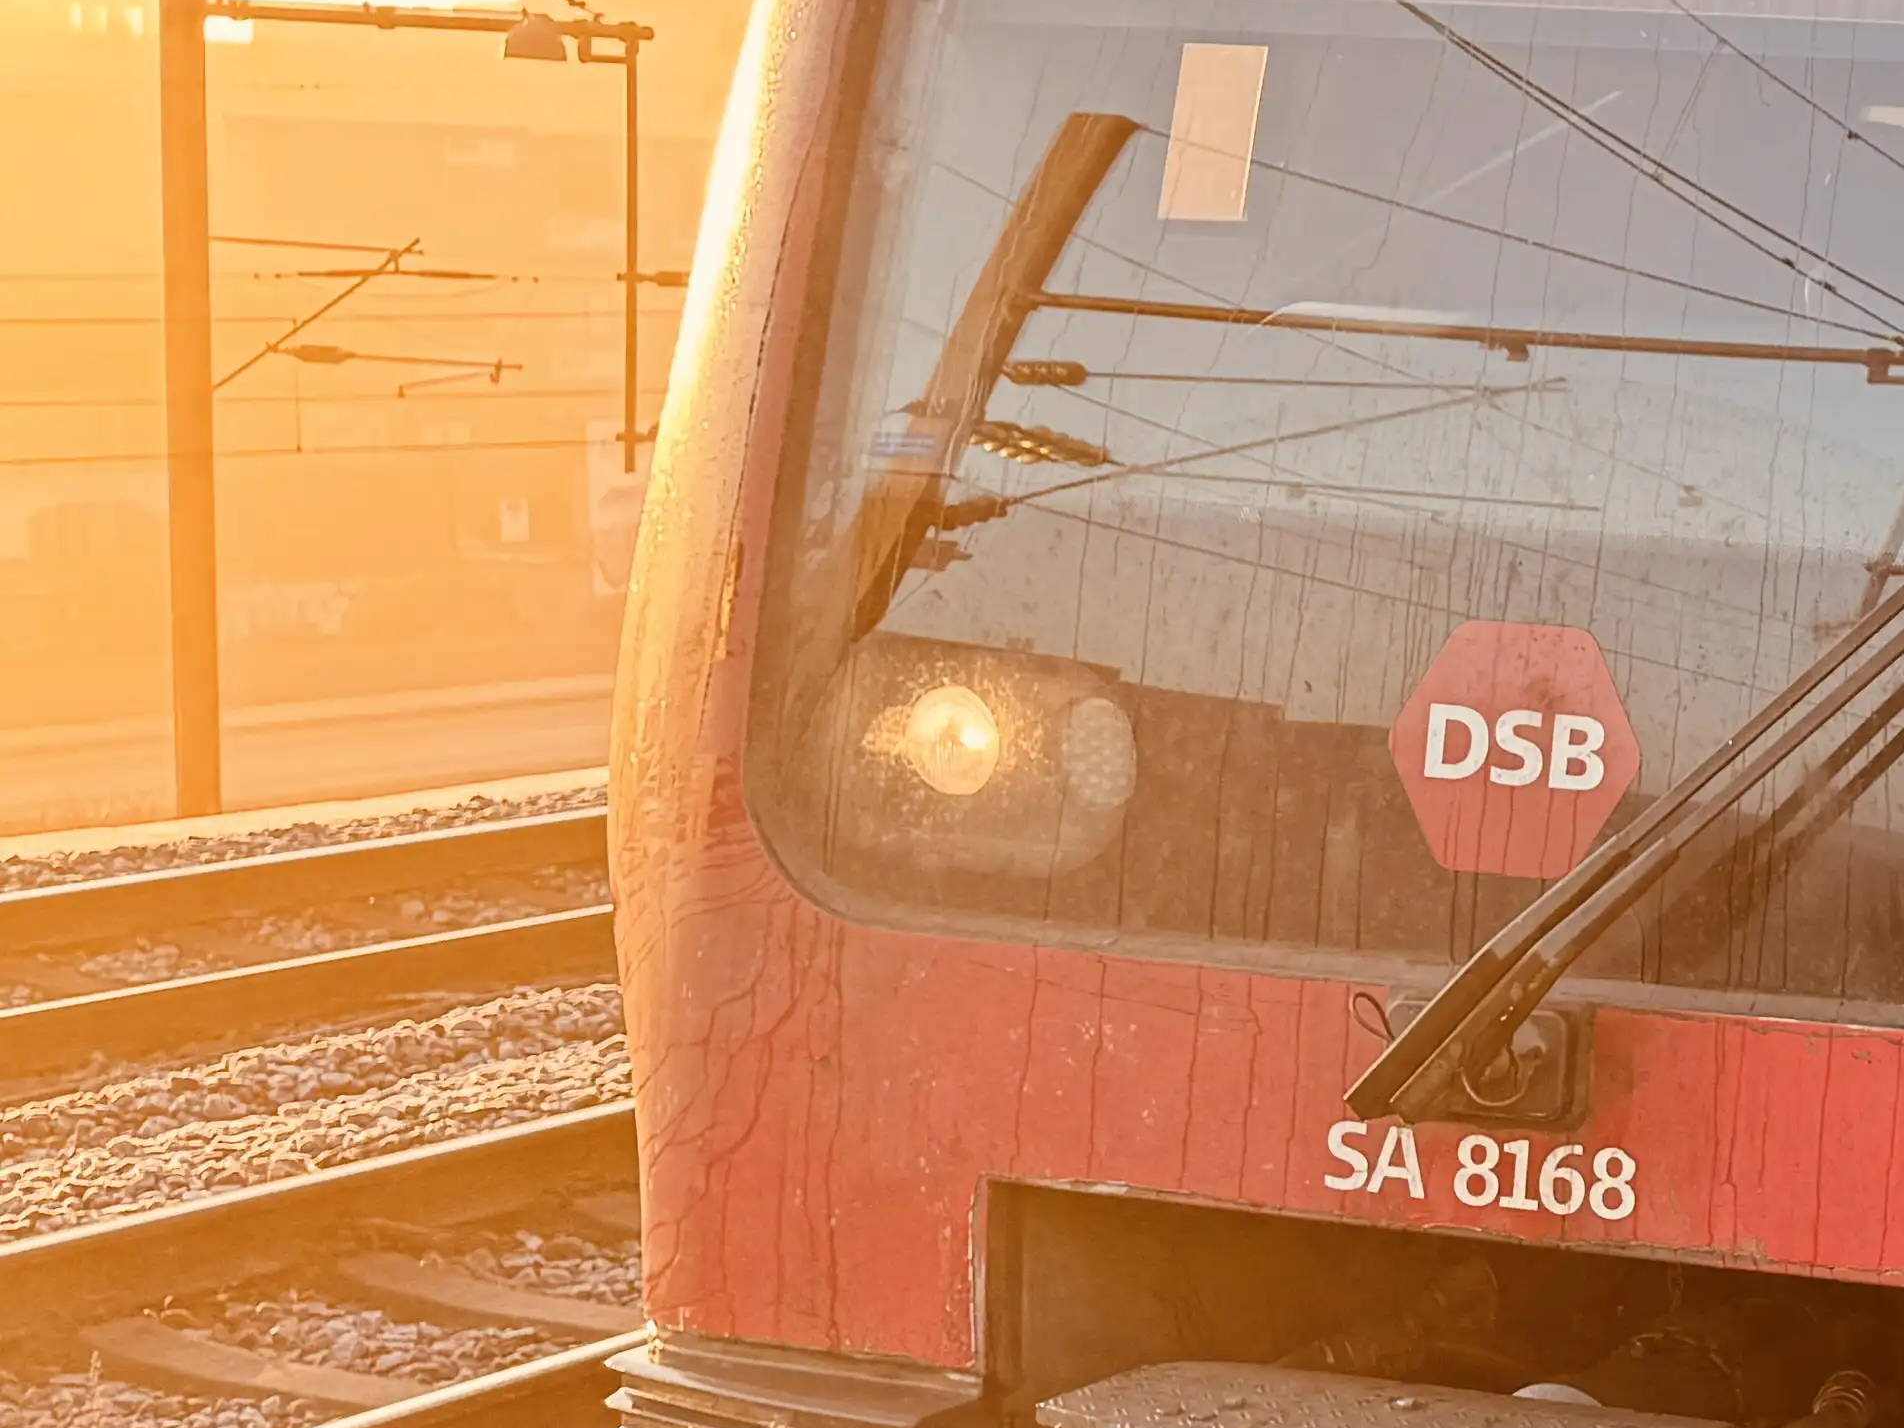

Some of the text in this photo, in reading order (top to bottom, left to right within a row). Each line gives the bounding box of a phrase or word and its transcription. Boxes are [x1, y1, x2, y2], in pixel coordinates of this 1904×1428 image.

[1422, 703, 1607, 791] DSB
[1323, 1120, 1637, 1220] SA 8168
